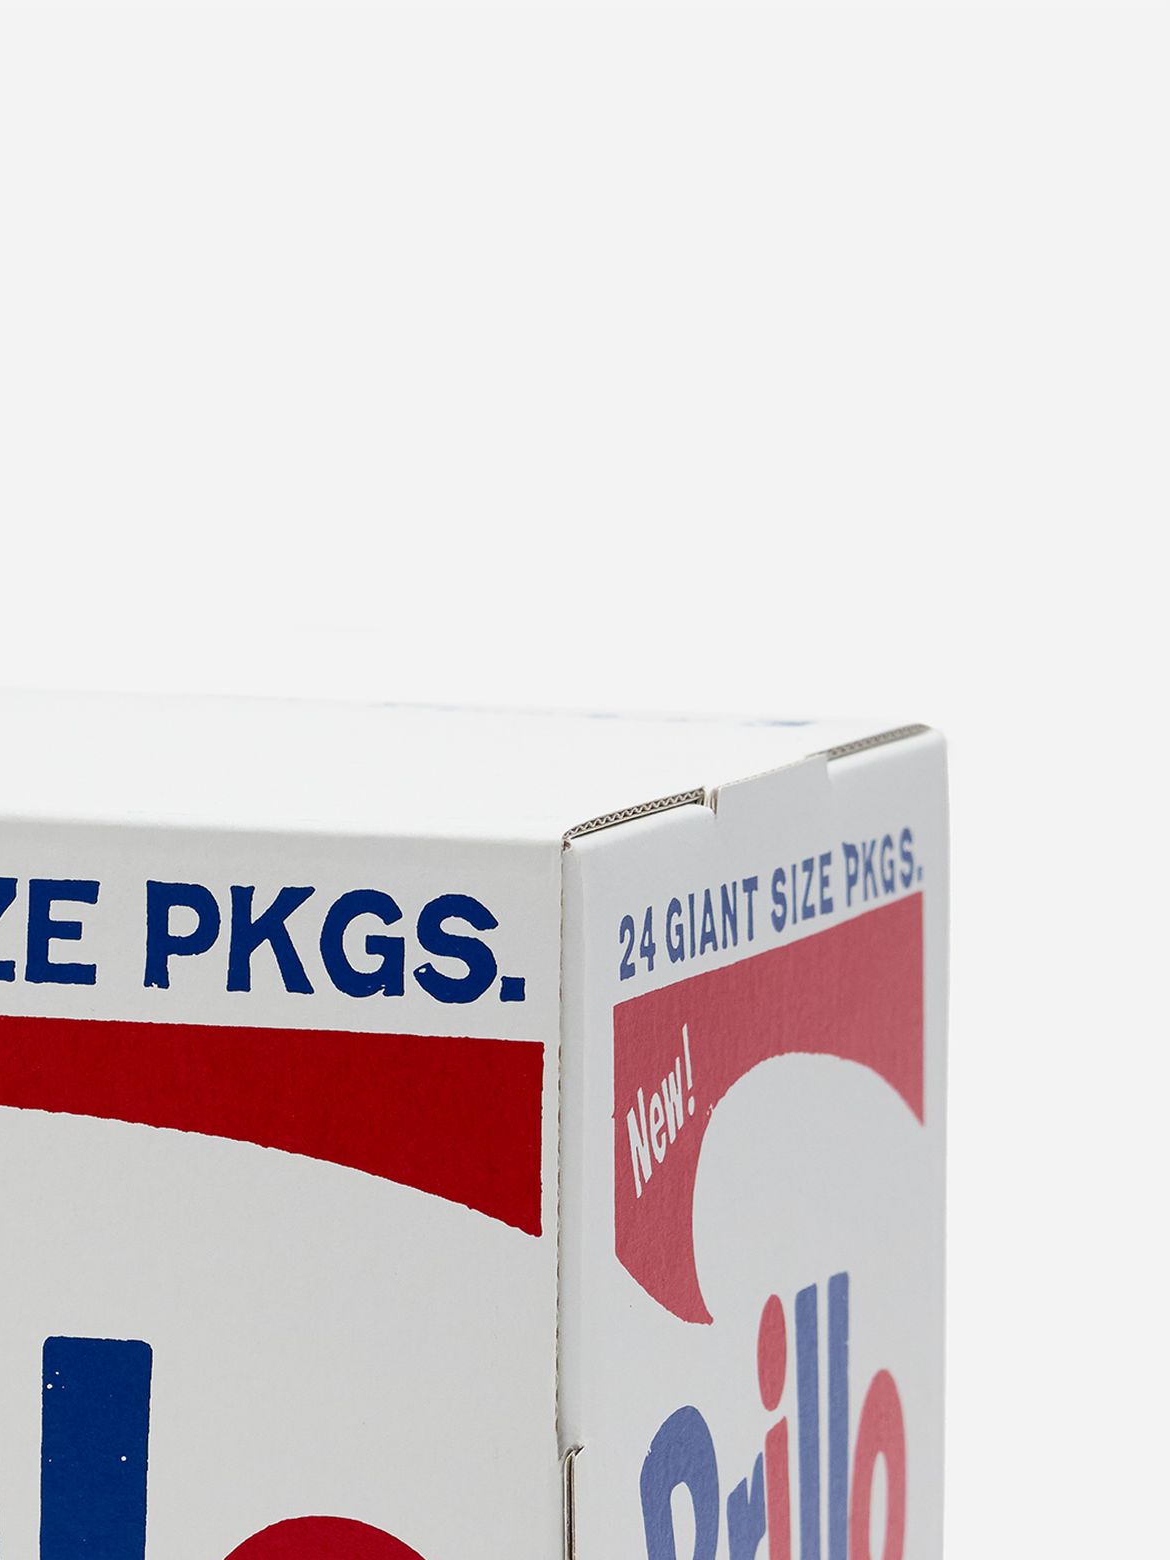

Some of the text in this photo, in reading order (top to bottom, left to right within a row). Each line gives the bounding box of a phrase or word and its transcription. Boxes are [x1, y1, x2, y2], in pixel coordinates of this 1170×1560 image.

[143, 879, 527, 1004] PKGS.
[619, 826, 923, 982] 24 GIANT SIZE PKGS.
[626, 1022, 696, 1200] New!
